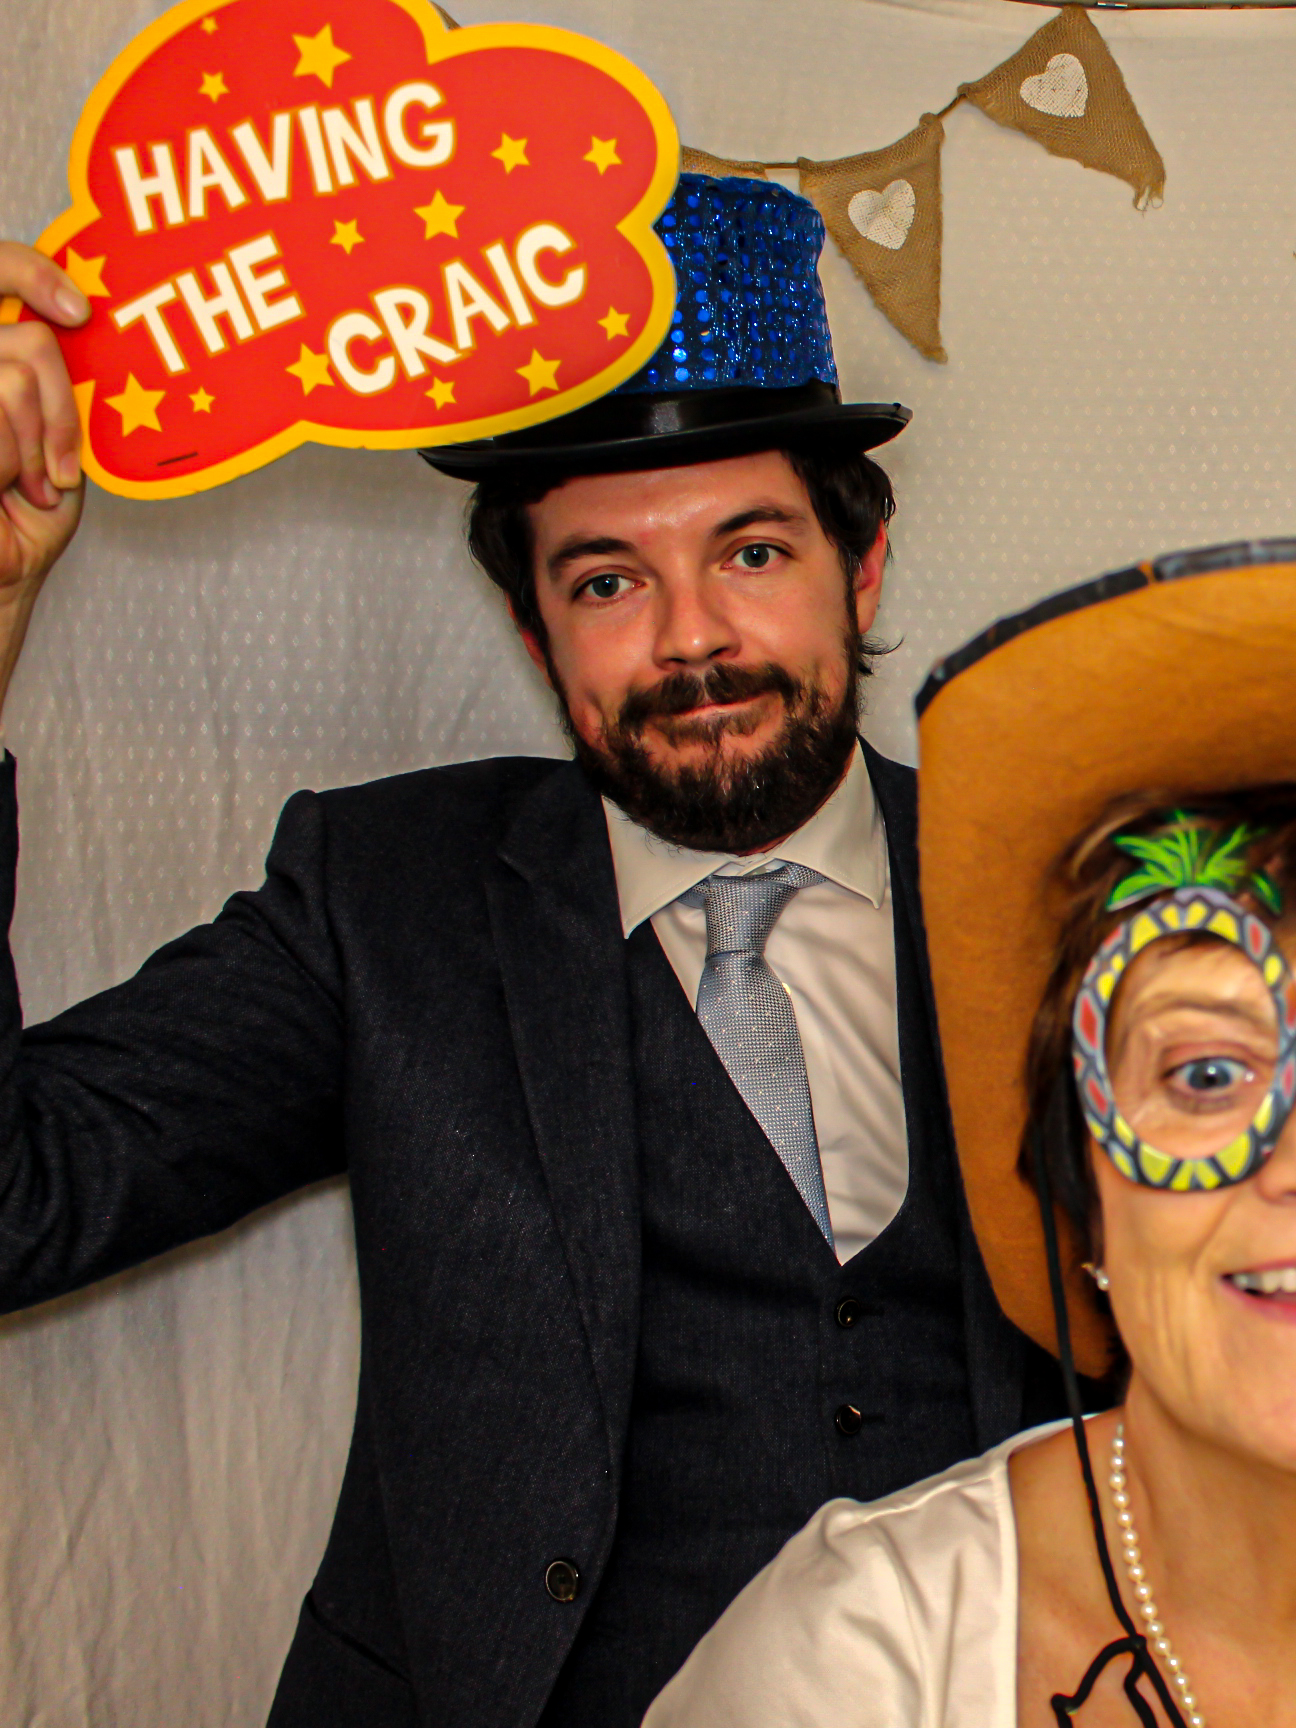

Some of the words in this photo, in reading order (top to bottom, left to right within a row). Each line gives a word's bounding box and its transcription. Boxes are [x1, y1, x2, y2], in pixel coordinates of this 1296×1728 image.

[114, 83, 455, 233] HAVING
[113, 233, 303, 374] THE
[327, 223, 586, 395] CRAIC
